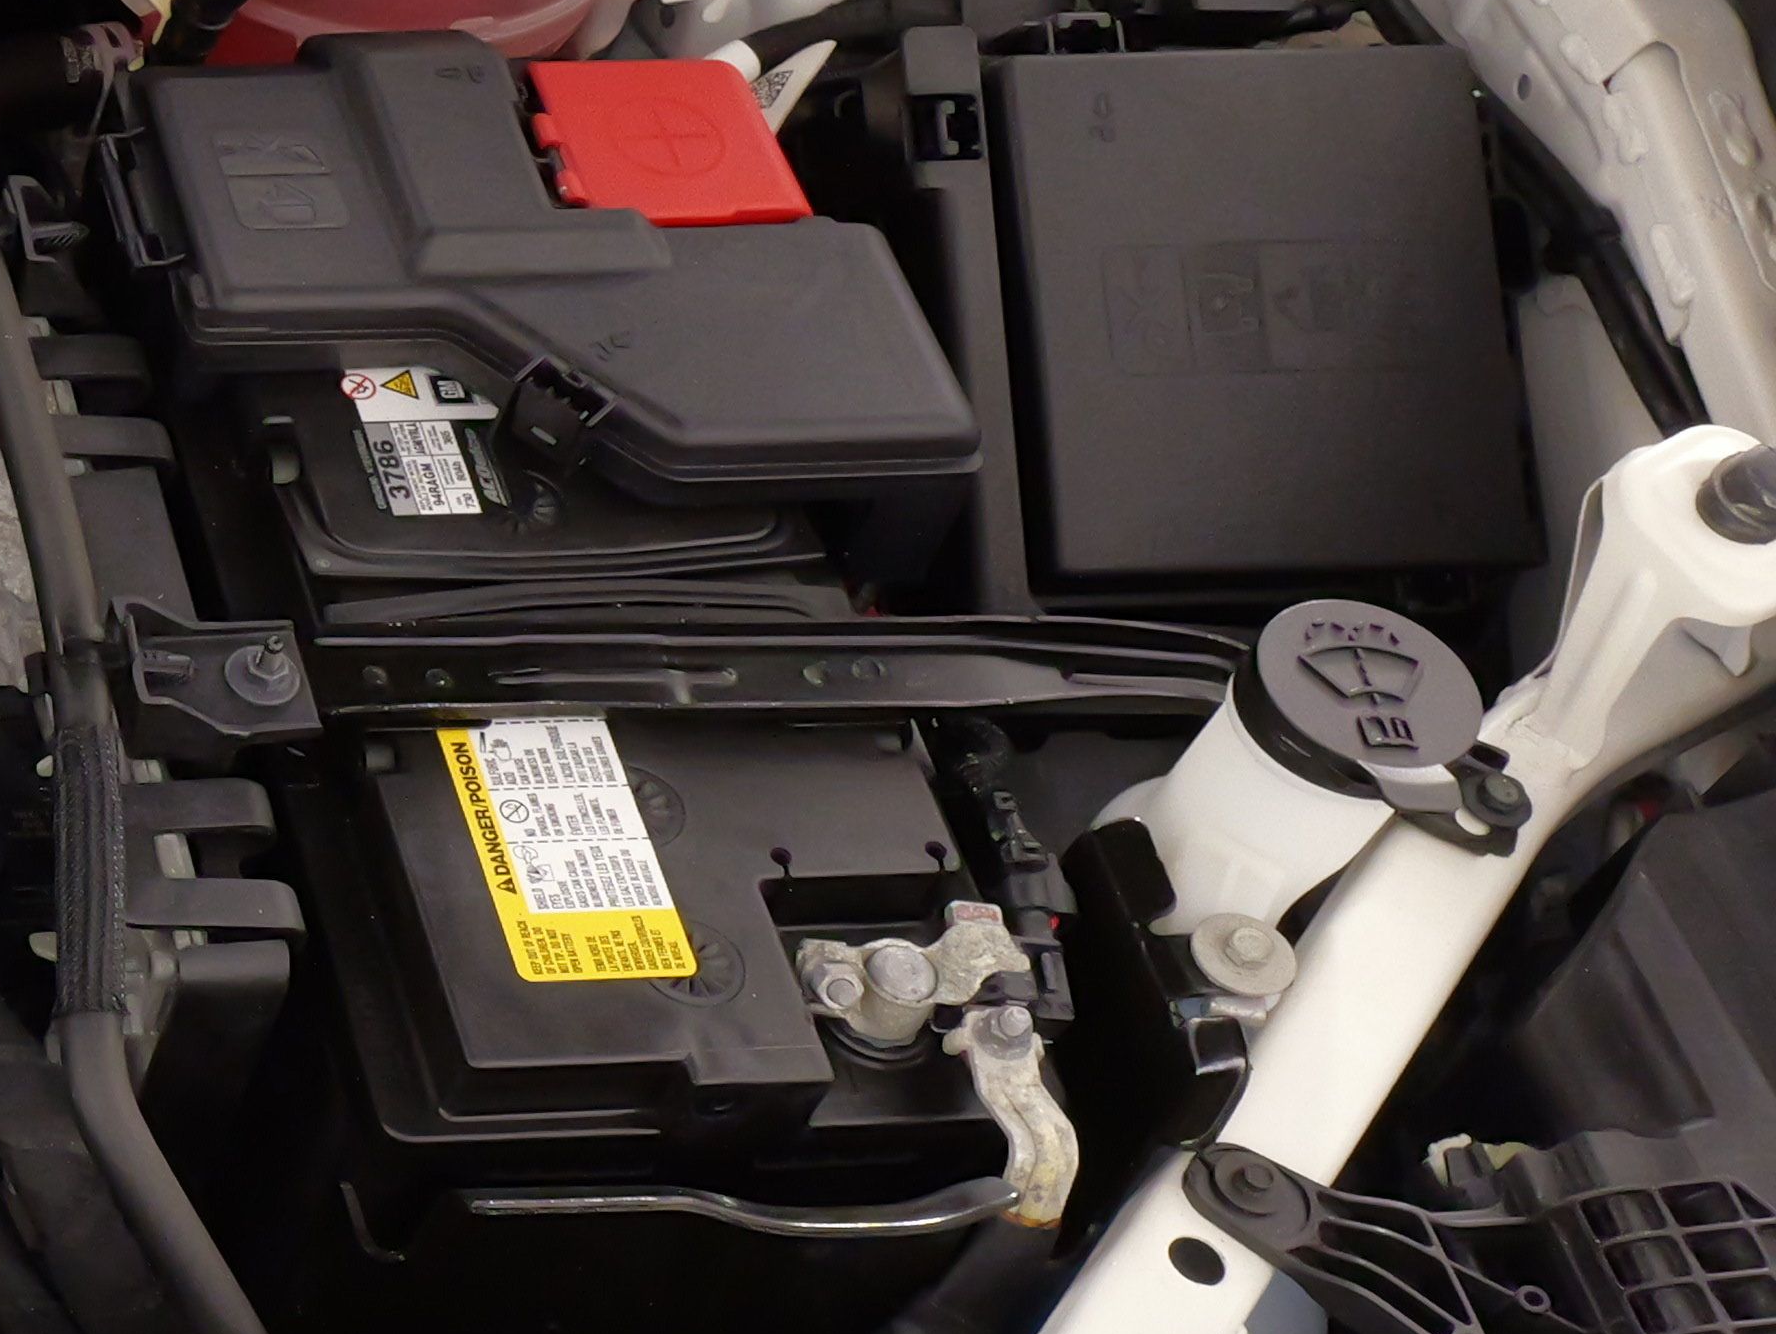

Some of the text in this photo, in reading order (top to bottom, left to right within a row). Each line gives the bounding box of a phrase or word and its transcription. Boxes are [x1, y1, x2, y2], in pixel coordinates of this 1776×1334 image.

[374, 440, 410, 499] 3786
[420, 463, 445, 506] 94RAGM
[451, 741, 510, 875] DANGER/POISON
